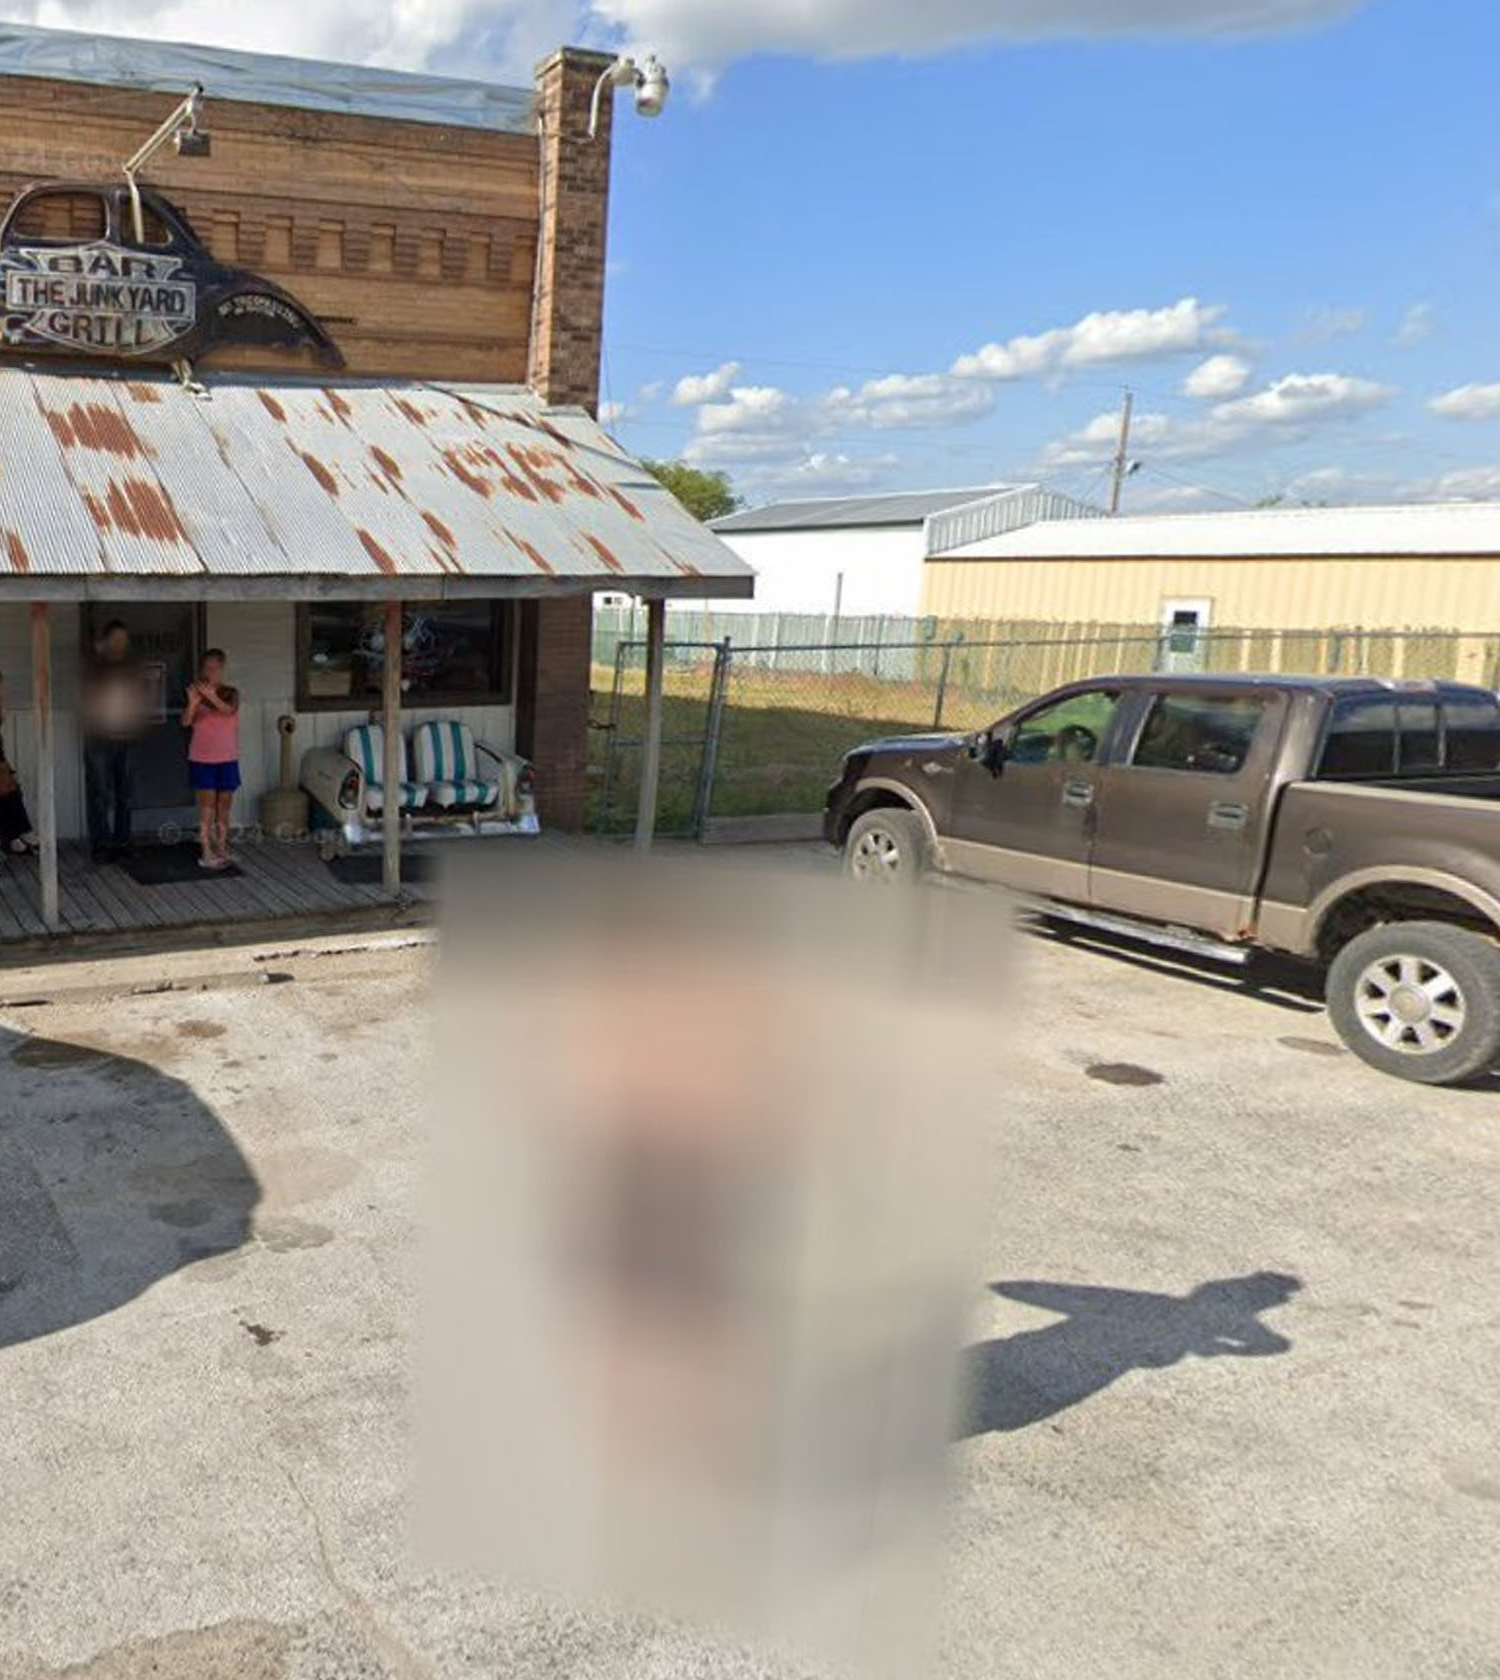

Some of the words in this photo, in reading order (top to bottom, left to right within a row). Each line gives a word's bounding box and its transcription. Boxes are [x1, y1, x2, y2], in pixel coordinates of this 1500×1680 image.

[48, 250, 157, 279] BAR
[18, 277, 66, 305] THE
[49, 311, 155, 346] GRILL
